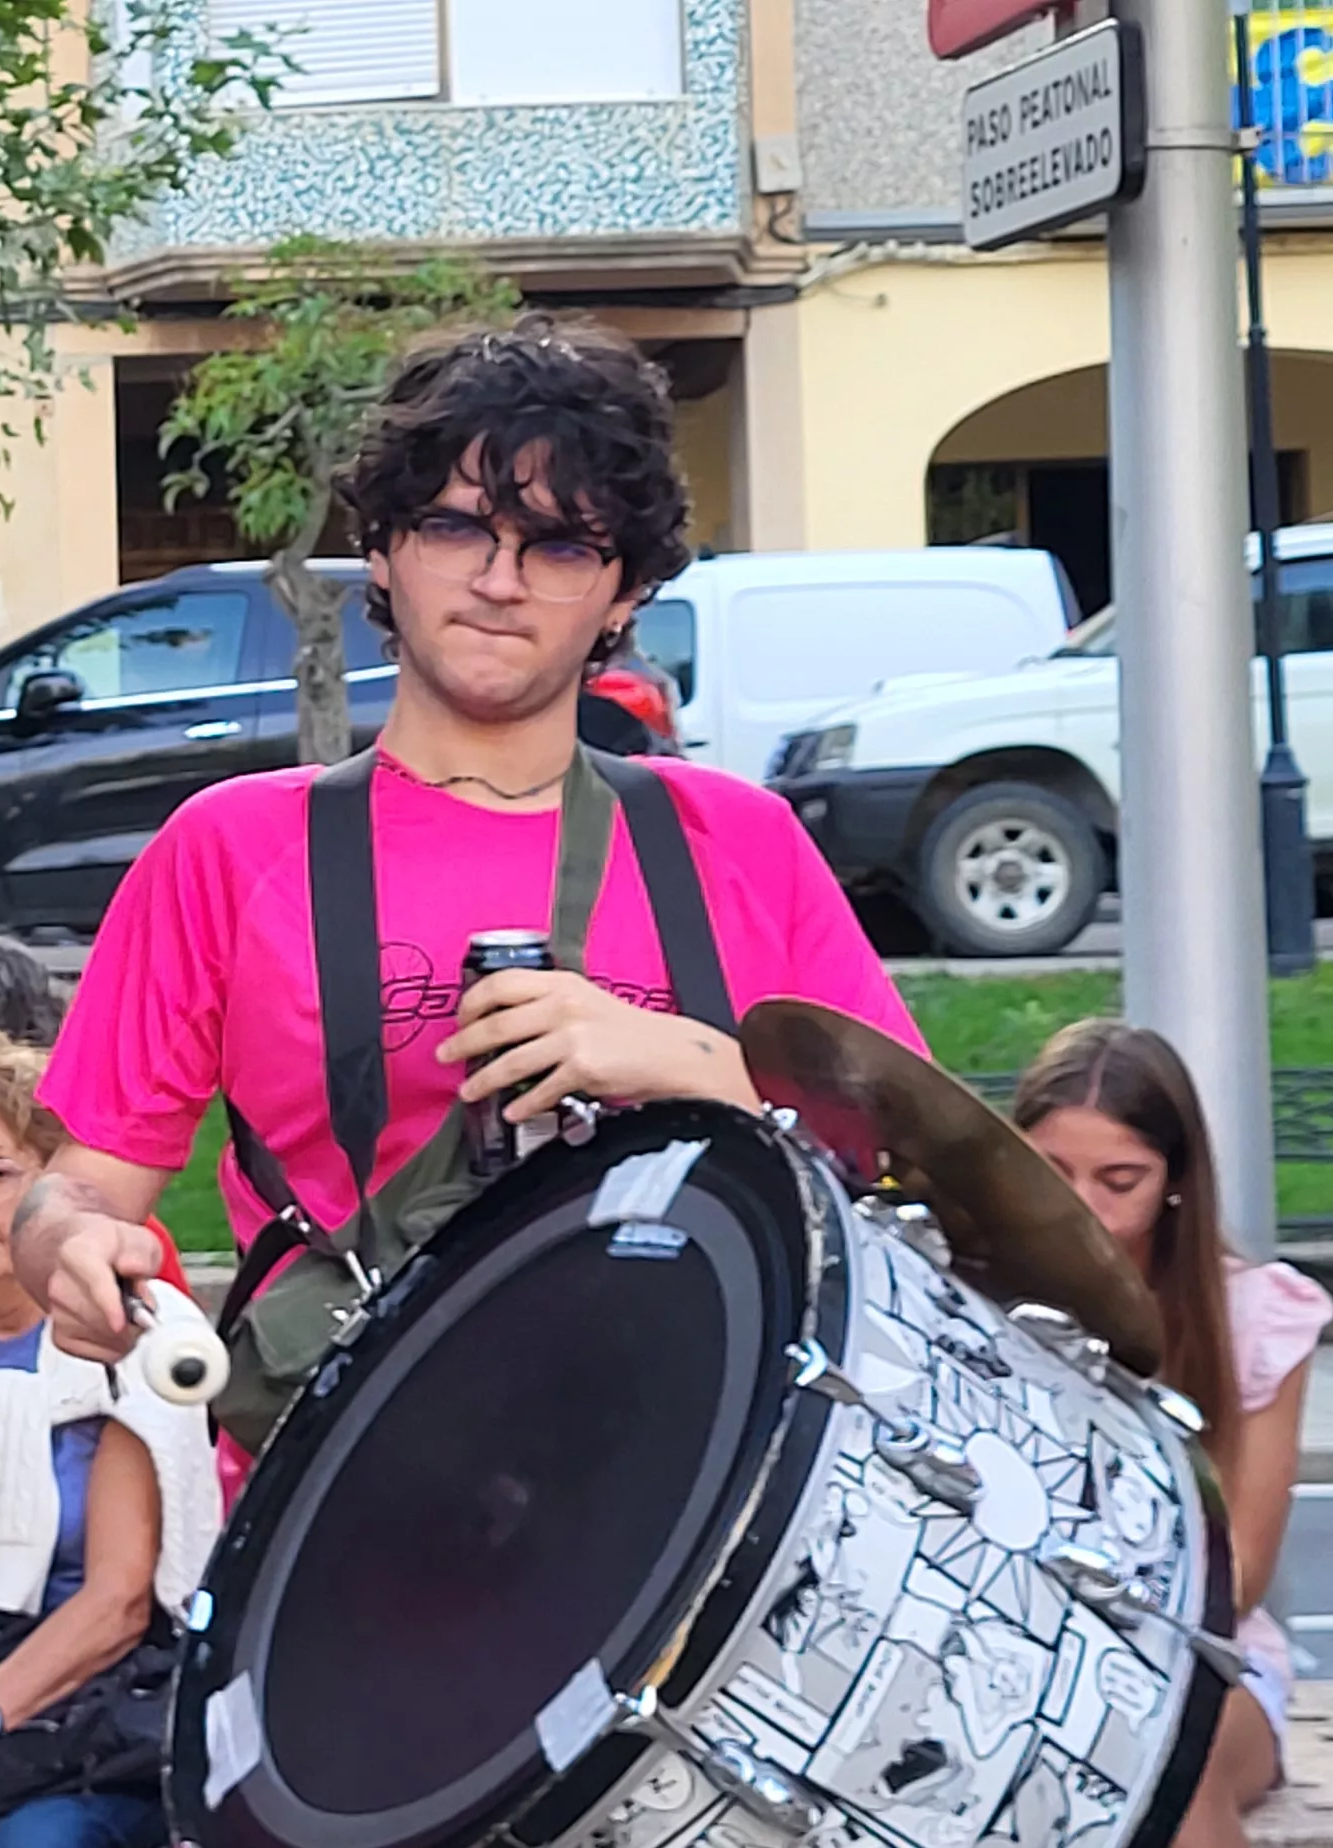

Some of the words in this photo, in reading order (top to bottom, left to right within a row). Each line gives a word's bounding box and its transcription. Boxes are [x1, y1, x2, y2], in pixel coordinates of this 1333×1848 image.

[967, 103, 1010, 155] PASO
[1021, 60, 1112, 134] PEATONAL
[970, 128, 1113, 217] SOBREELEVADO
